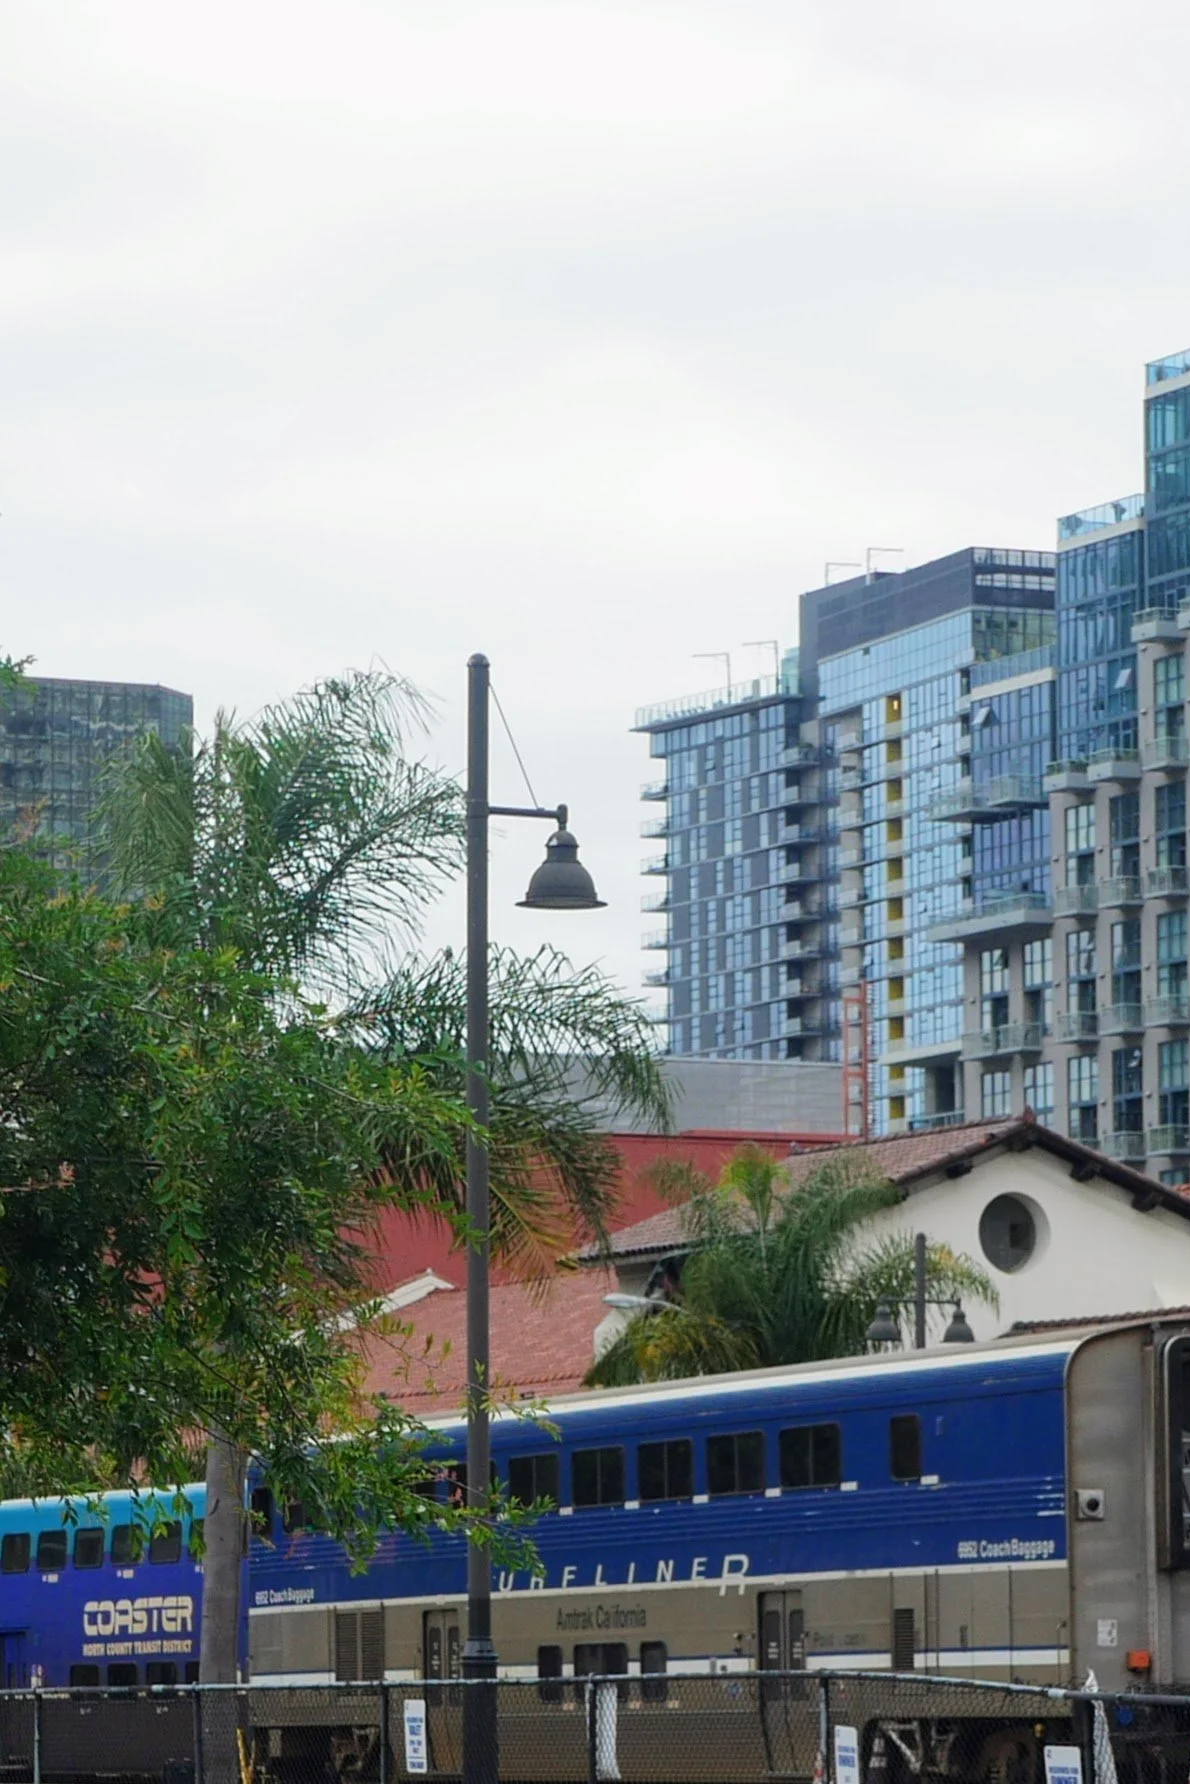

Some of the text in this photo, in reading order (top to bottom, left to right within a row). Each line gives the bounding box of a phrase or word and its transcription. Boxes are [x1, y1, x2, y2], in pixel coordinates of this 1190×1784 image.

[493, 1554, 749, 1596] URFLINER
[83, 1595, 193, 1636] COASTER
[556, 1604, 646, 1630] Amtrak California
[83, 1639, 192, 1656] NORTH COUNTY TRANSIT DISTRICT
